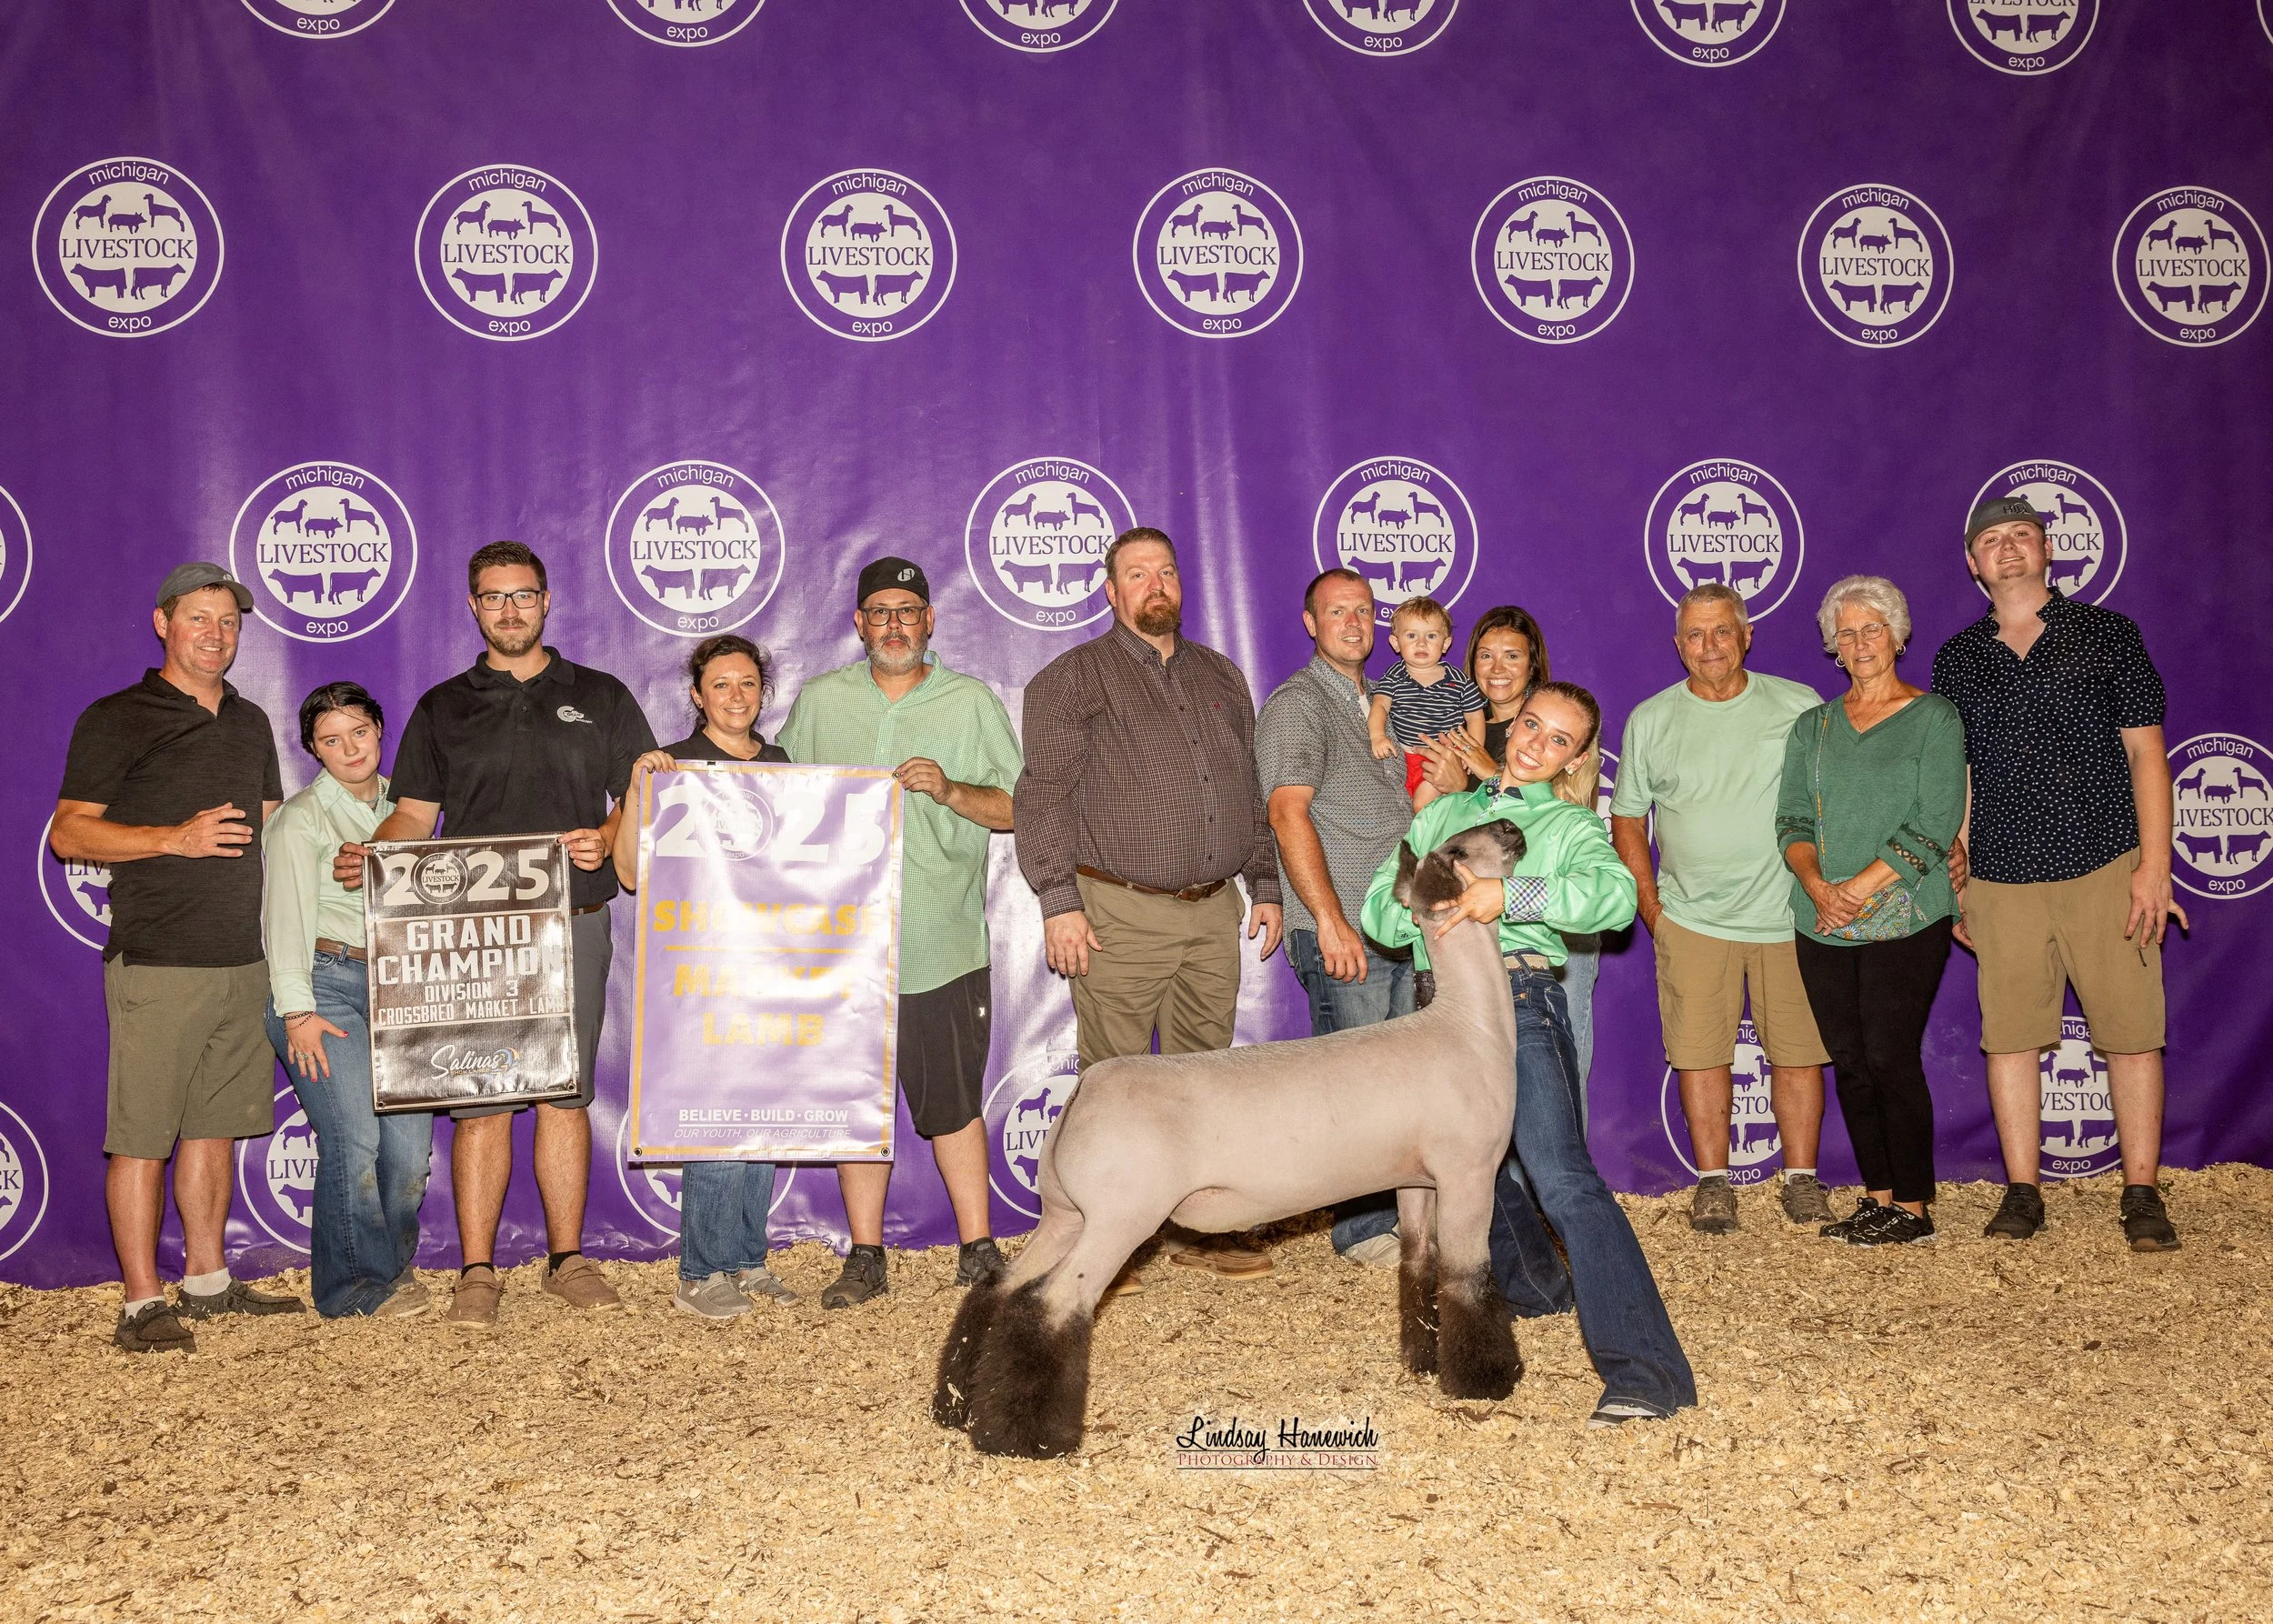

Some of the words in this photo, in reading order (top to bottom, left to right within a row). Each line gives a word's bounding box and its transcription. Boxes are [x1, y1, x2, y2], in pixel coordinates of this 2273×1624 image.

[296, 17, 341, 35] expo
[666, 25, 708, 43] expo
[1021, 32, 1061, 48] expo
[1364, 35, 1403, 52] expo
[1692, 46, 1730, 63] expo
[2008, 56, 2046, 72] expo
[88, 161, 169, 185] michigan
[468, 168, 546, 193] michigan
[831, 173, 907, 195] michigan
[1181, 172, 1254, 196] michigan
[1517, 180, 1588, 204] michigan
[1841, 187, 1909, 210] michigan
[2156, 190, 2225, 212] michigan
[61, 237, 195, 259] LIVESTOCK
[443, 243, 570, 265] LIVESTOCK
[808, 246, 931, 266] LIVESTOCK
[1159, 245, 1277, 266] LIVESTOCK
[1497, 250, 1610, 272] LIVESTOCK
[1821, 256, 1930, 277] LIVESTOCK
[2138, 258, 2248, 277] LIVESTOCK
[108, 316, 152, 333] expo
[488, 319, 531, 336] expo
[852, 321, 893, 337] expo
[1202, 317, 1242, 334] expo
[1537, 324, 1576, 340] expo
[2179, 327, 2216, 343] expo
[1861, 328, 1898, 344] expo
[285, 466, 365, 490] michigan
[656, 465, 735, 488] michigan
[1015, 461, 1090, 485] michigan
[1360, 460, 1430, 484] michigan
[1689, 463, 1758, 485] michigan
[2008, 464, 2078, 486] michigan
[632, 539, 758, 561] LIVESTOCK
[991, 534, 1113, 556] LIVESTOCK
[1339, 532, 1453, 553] LIVESTOCK
[1668, 534, 1780, 553] LIVESTOCK
[259, 542, 389, 565] LIVESTOCK
[676, 614, 719, 633] expo
[1036, 609, 1076, 627] expo
[305, 620, 349, 638] expo
[2187, 737, 2254, 759] michigan
[422, 875, 460, 883] LIVESTOCK
[2208, 878, 2247, 895] expo
[653, 899, 878, 936] SHWCAS
[406, 915, 532, 951] GRAND
[377, 945, 564, 986] CHAMPION
[425, 982, 492, 1003] DIVISION
[506, 979, 518, 997] 3
[378, 1003, 455, 1027] CROSSBRED
[466, 999, 519, 1019] MARKET
[529, 997, 565, 1015] LAMB
[702, 1013, 826, 1047] LAMB
[430, 1044, 502, 1079] Salinas
[2040, 1092, 2114, 1111] VESTOC
[678, 1108, 742, 1122] BELIEVE
[750, 1108, 796, 1122] BUILD
[804, 1109, 848, 1122] GROW
[674, 1128, 700, 1138] OUR
[746, 1128, 772, 1138] OUR
[773, 1128, 852, 1138] AGRICULTURE
[1727, 1167, 1762, 1186] expo
[2052, 1159, 2091, 1174] expo
